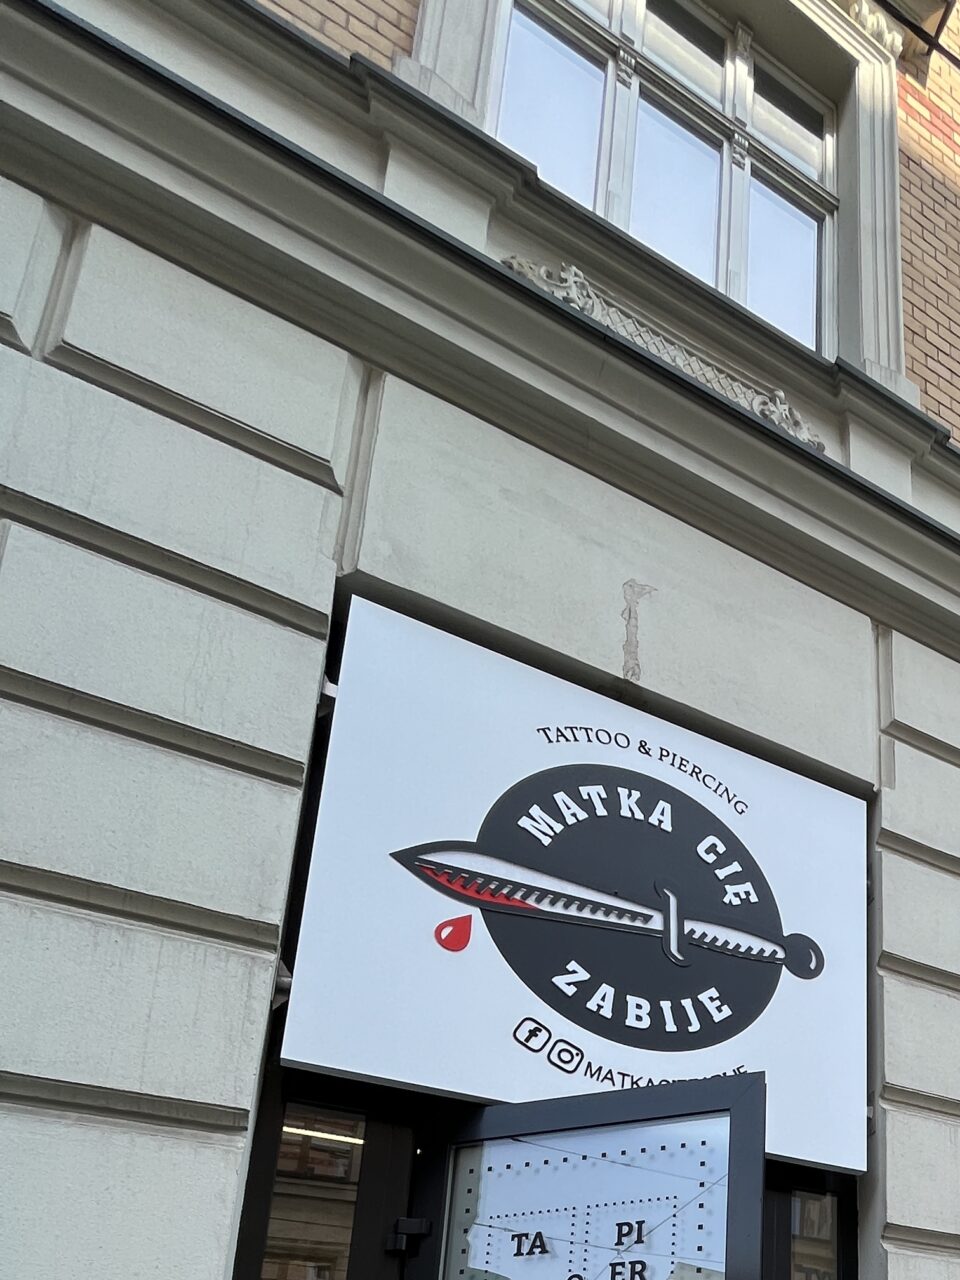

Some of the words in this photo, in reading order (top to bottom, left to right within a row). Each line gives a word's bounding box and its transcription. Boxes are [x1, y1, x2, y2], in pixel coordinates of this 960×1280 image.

[536, 726, 631, 749] TATTOO
[638, 740, 652, 757] &
[658, 746, 749, 816] PIERCING
[517, 785, 673, 847] MATKA
[696, 835, 759, 906] CIĘ
[551, 960, 733, 1033] ZABIJE
[511, 1231, 549, 1257] TA
[614, 1220, 646, 1246] PI
